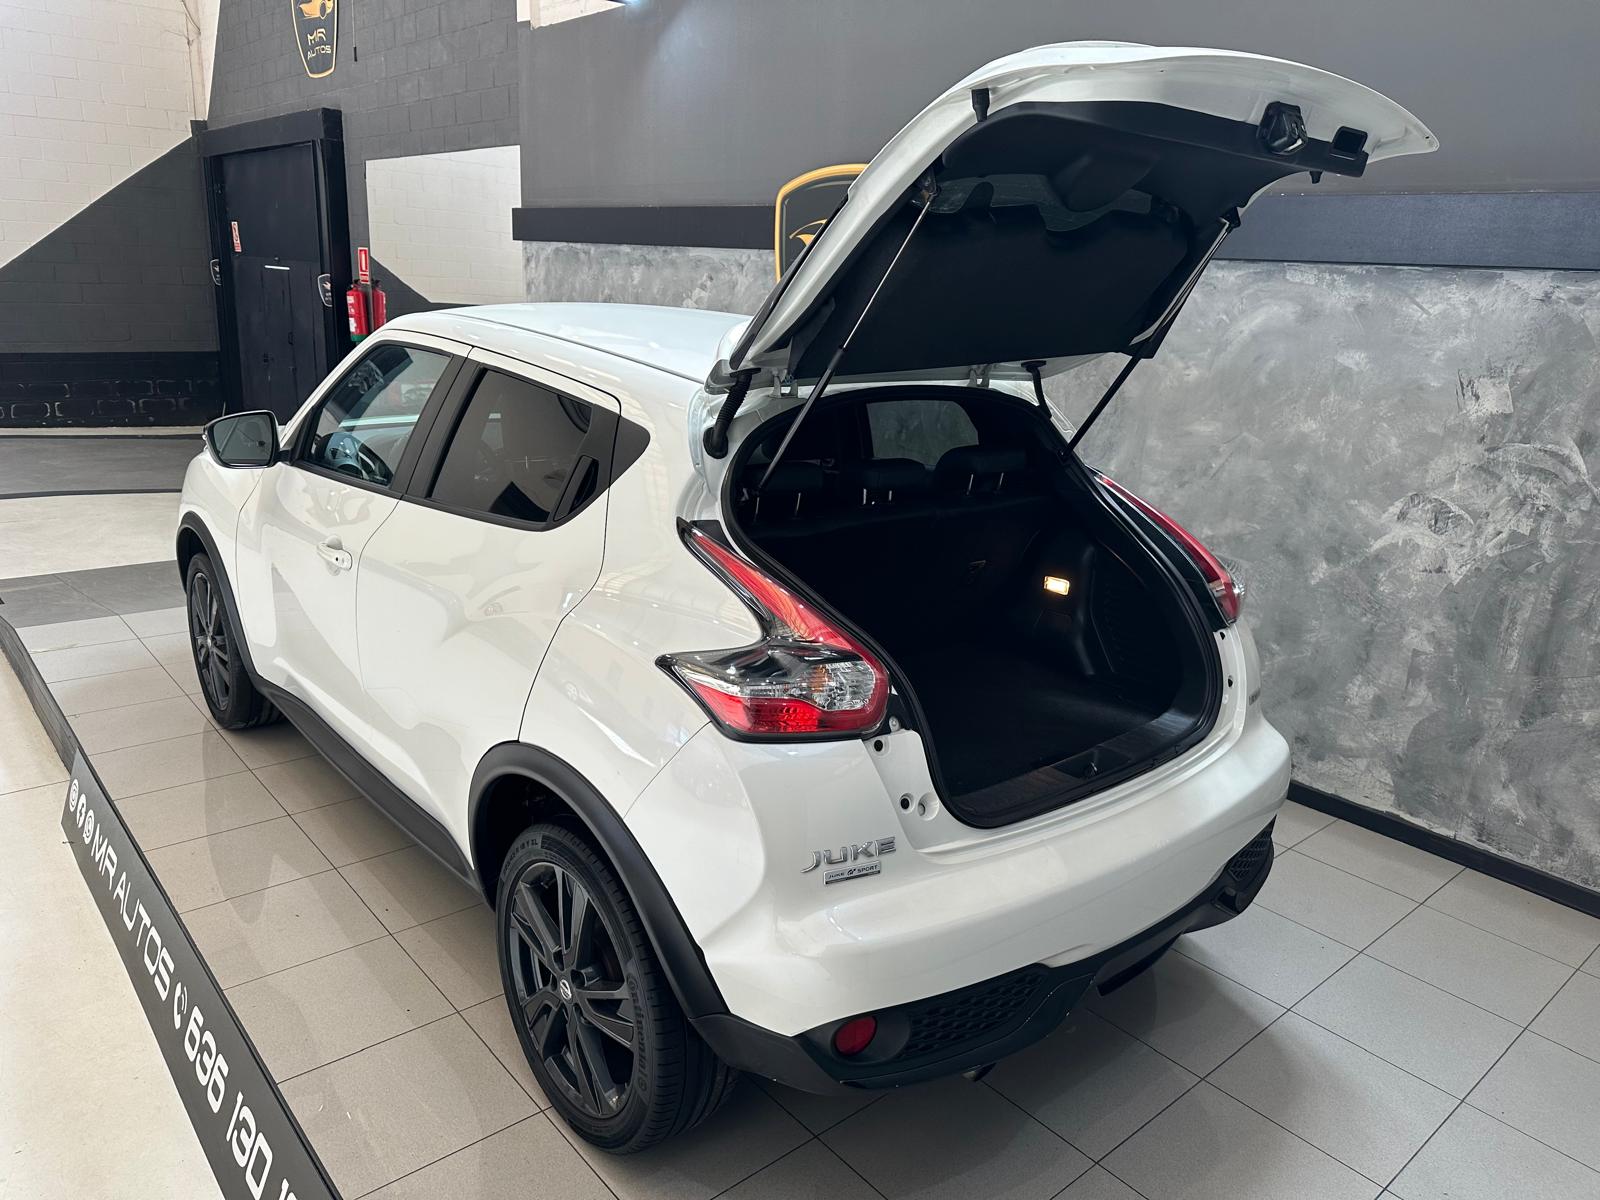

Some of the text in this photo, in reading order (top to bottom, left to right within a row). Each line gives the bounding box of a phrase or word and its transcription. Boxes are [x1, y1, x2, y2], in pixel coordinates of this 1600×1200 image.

[307, 28, 327, 46] MR
[307, 44, 332, 60] AUTOS
[800, 836, 896, 873] JUKE
[857, 864, 878, 874] SPORT
[90, 823, 273, 1200] MR AUTOS 636 130
